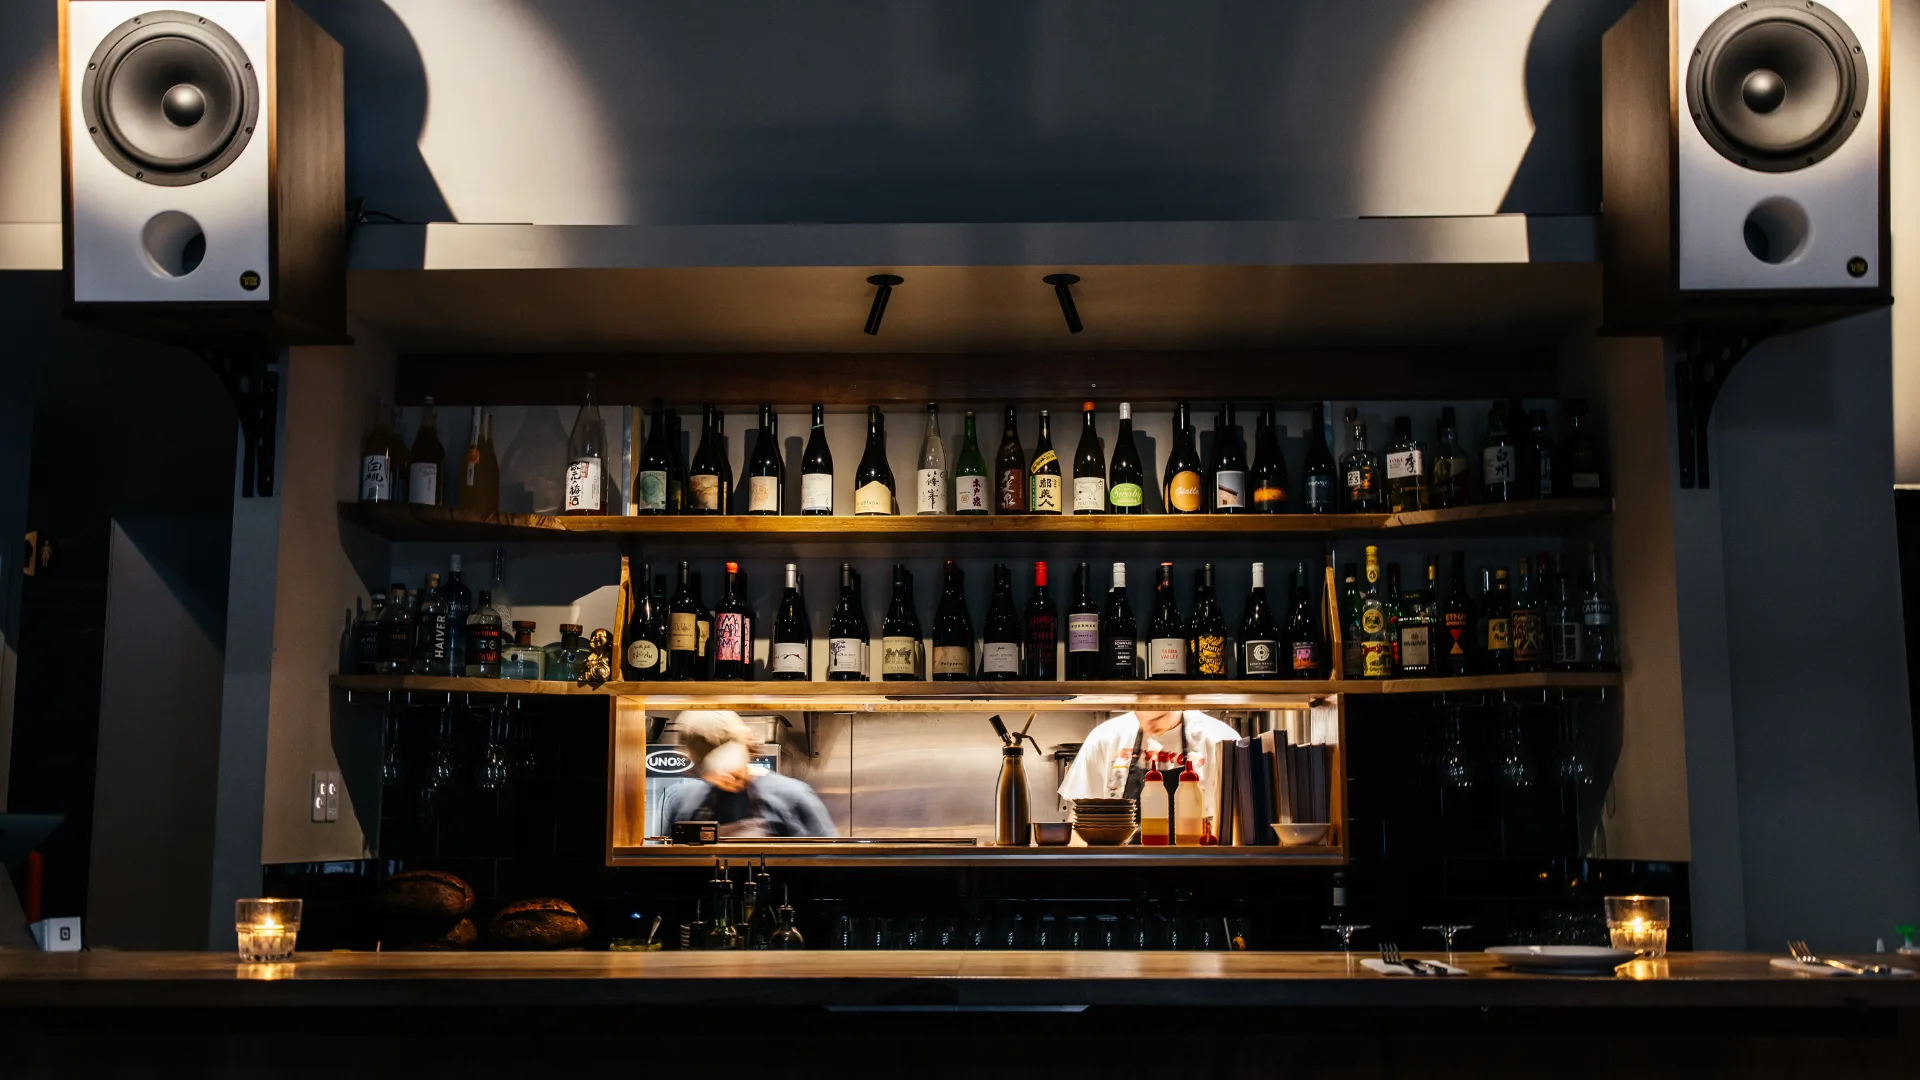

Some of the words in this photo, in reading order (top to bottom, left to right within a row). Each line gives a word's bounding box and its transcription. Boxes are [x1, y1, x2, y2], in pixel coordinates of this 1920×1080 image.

[365, 456, 383, 482] 白桃
[1112, 487, 1142, 500] Swaby
[434, 616, 446, 658] HAIVER
[649, 757, 685, 766] UNOX
